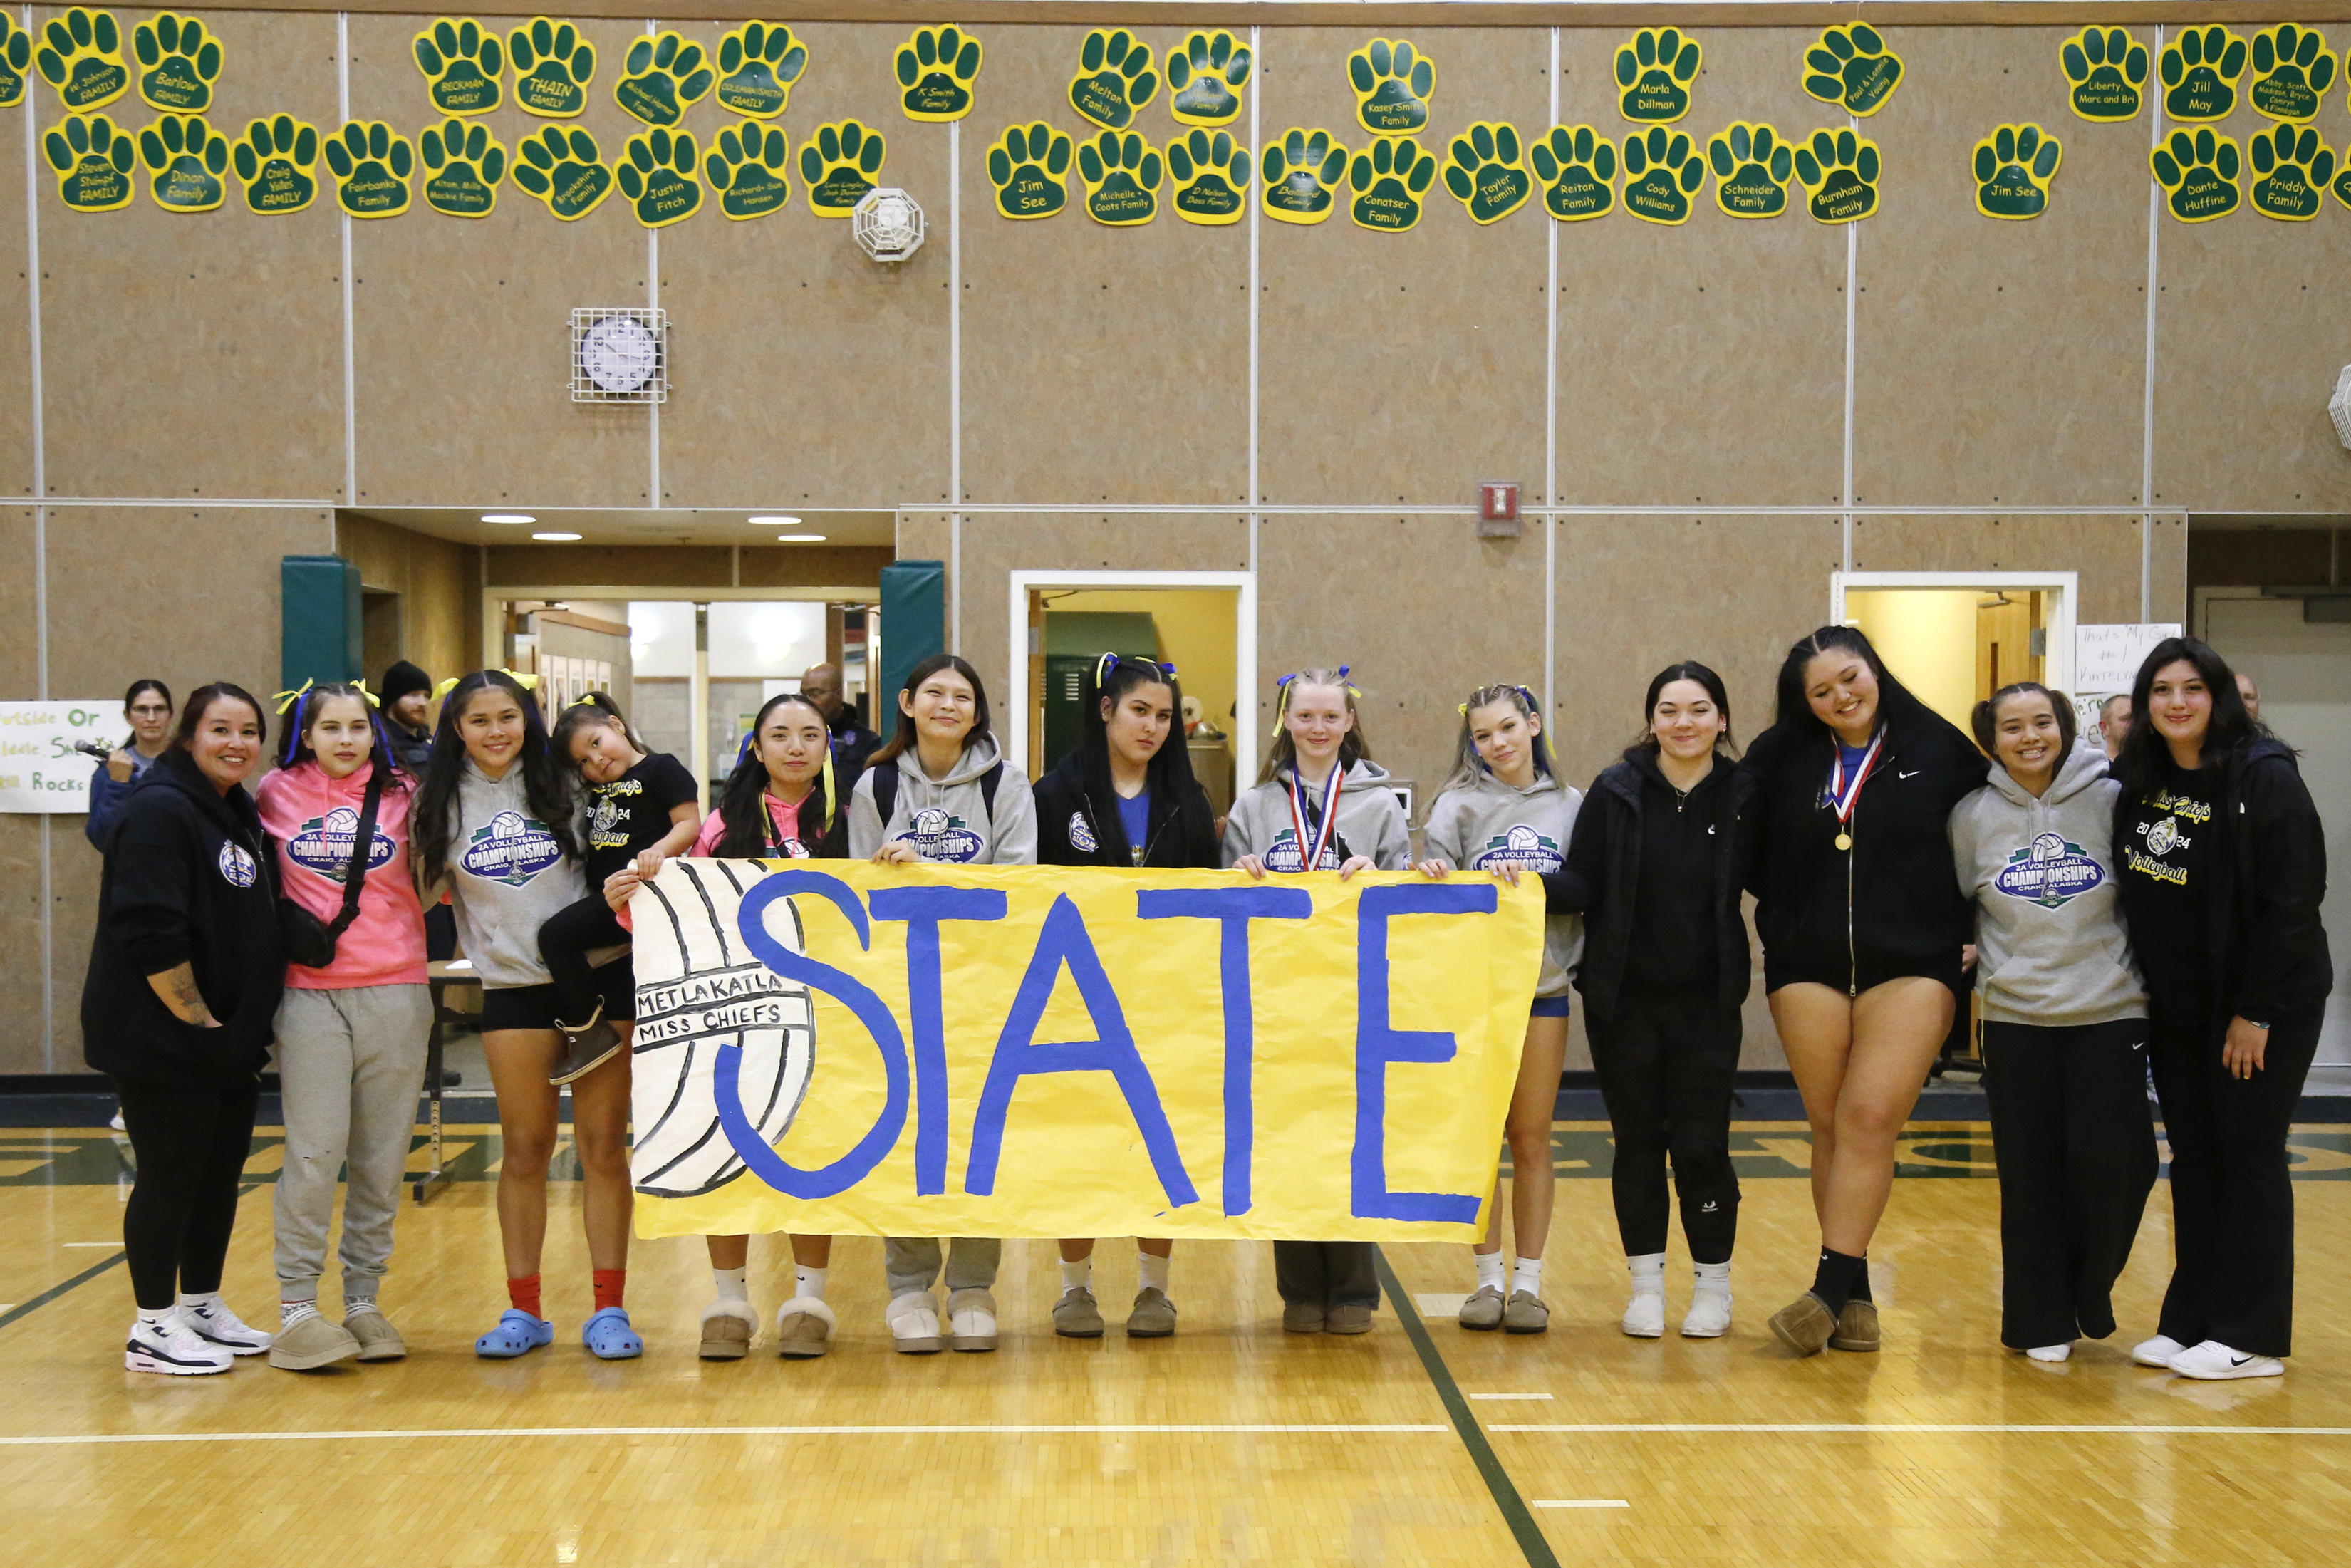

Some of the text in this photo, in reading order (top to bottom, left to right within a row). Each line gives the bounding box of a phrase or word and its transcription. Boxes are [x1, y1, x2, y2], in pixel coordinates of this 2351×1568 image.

[80, 78, 117, 103] FAMILY
[441, 78, 484, 92] BECKMAN
[529, 78, 574, 97] THAIN
[1089, 80, 1123, 105] Melton
[1640, 83, 1670, 94] Marla
[1849, 85, 1864, 103] Paul
[1862, 78, 1871, 88] &
[1869, 77, 1891, 98] Young
[2192, 81, 2210, 93] Jill
[446, 93, 481, 105] FAMILY
[529, 94, 566, 108] FAMILY
[921, 98, 951, 110] Family
[1638, 99, 1675, 110] Dillman
[2079, 94, 2135, 103] Marc and Bri
[2189, 99, 2212, 112] May
[1081, 94, 1114, 120] Family
[1369, 104, 1394, 114] Kasey
[1381, 115, 1410, 126] Family
[348, 180, 397, 193] Fairbanks
[649, 182, 685, 199] Justin
[1018, 180, 1044, 194] Jim
[1480, 175, 1510, 196] Taylor
[1560, 183, 1595, 194] Reitan
[1646, 182, 1670, 197] Cody
[1725, 184, 1776, 196] Schneider
[1991, 185, 2037, 197] Jim See
[2187, 180, 2219, 196] Dante
[2270, 177, 2306, 196] Priddy
[79, 186, 120, 202] FAMILY
[167, 185, 207, 203] Family
[261, 191, 302, 207] FAMILY
[358, 194, 390, 207] Family
[571, 183, 596, 206] Family
[1100, 190, 1135, 201] Michelle
[1485, 185, 1517, 207] Family
[1818, 184, 1863, 206] Burnham
[2266, 192, 2304, 210] Family
[656, 197, 686, 212] Fitch
[1021, 197, 1047, 209] See
[1096, 199, 1149, 212] Coats Family
[1364, 195, 1411, 209] Conatser
[1562, 197, 1597, 209] Family
[1636, 194, 1676, 212] Williams
[1733, 196, 1766, 210] Family
[1830, 200, 1863, 218] Family
[2185, 194, 2226, 212] Huffine
[1369, 210, 1402, 226] Family
[68, 709, 100, 727] Or
[33, 772, 83, 792] Rocks
[618, 809, 630, 820] 24
[2137, 822, 2150, 835] 20
[490, 835, 544, 848] VOLLEYBALL
[2176, 836, 2191, 849] 24
[468, 840, 558, 869] CHAMPIONSHIPS
[2029, 858, 2083, 870] VOLLEYBALL
[2124, 845, 2187, 886] Volleyball
[638, 974, 783, 1016] METLAKATLA
[640, 1004, 781, 1042] MISS CHIEFS
[713, 870, 1498, 1224] STATE
